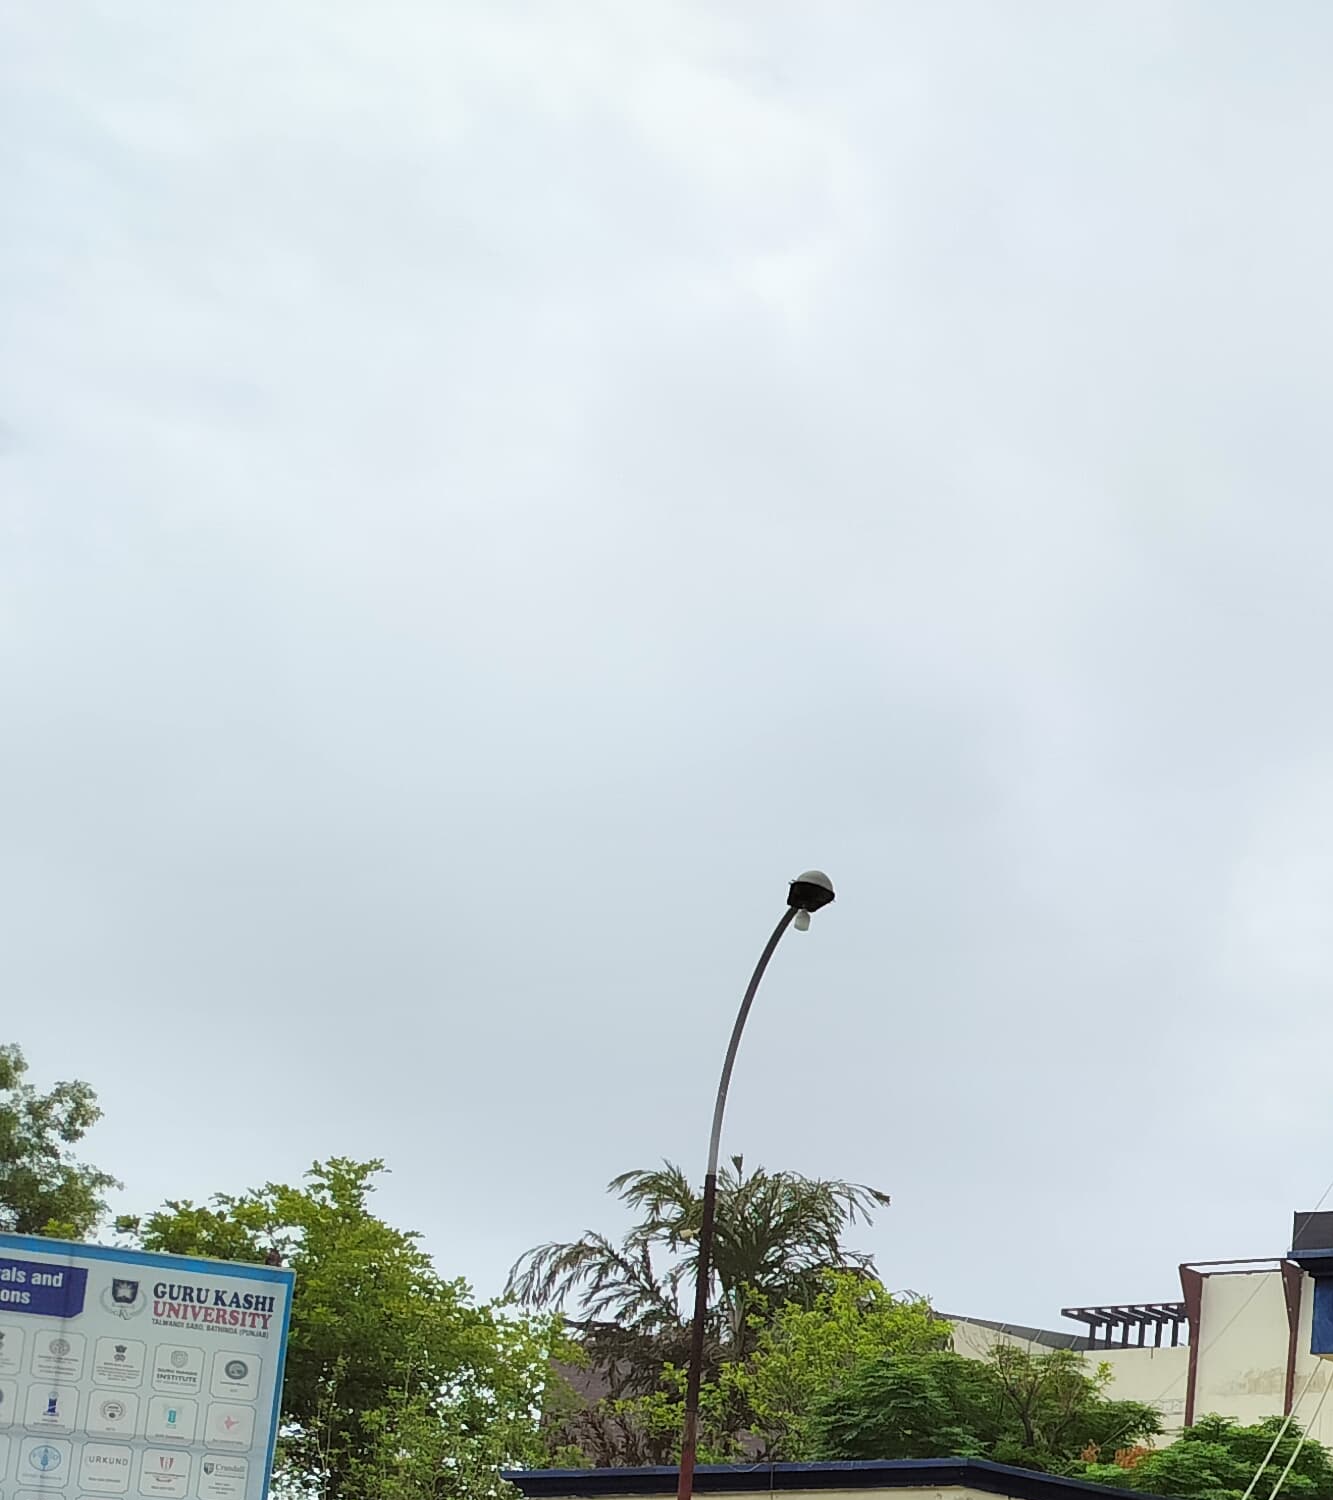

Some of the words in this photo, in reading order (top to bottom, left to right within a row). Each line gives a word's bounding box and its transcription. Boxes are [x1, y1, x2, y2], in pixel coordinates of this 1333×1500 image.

[0, 1267, 26, 1283] als
[31, 1272, 64, 1288] and
[153, 1282, 210, 1304] GURU
[213, 1289, 276, 1313] KASHI
[153, 1301, 272, 1330] UNIVERSITY
[156, 1373, 197, 1383] INSTITUTE
[88, 1455, 129, 1466] URKUND
